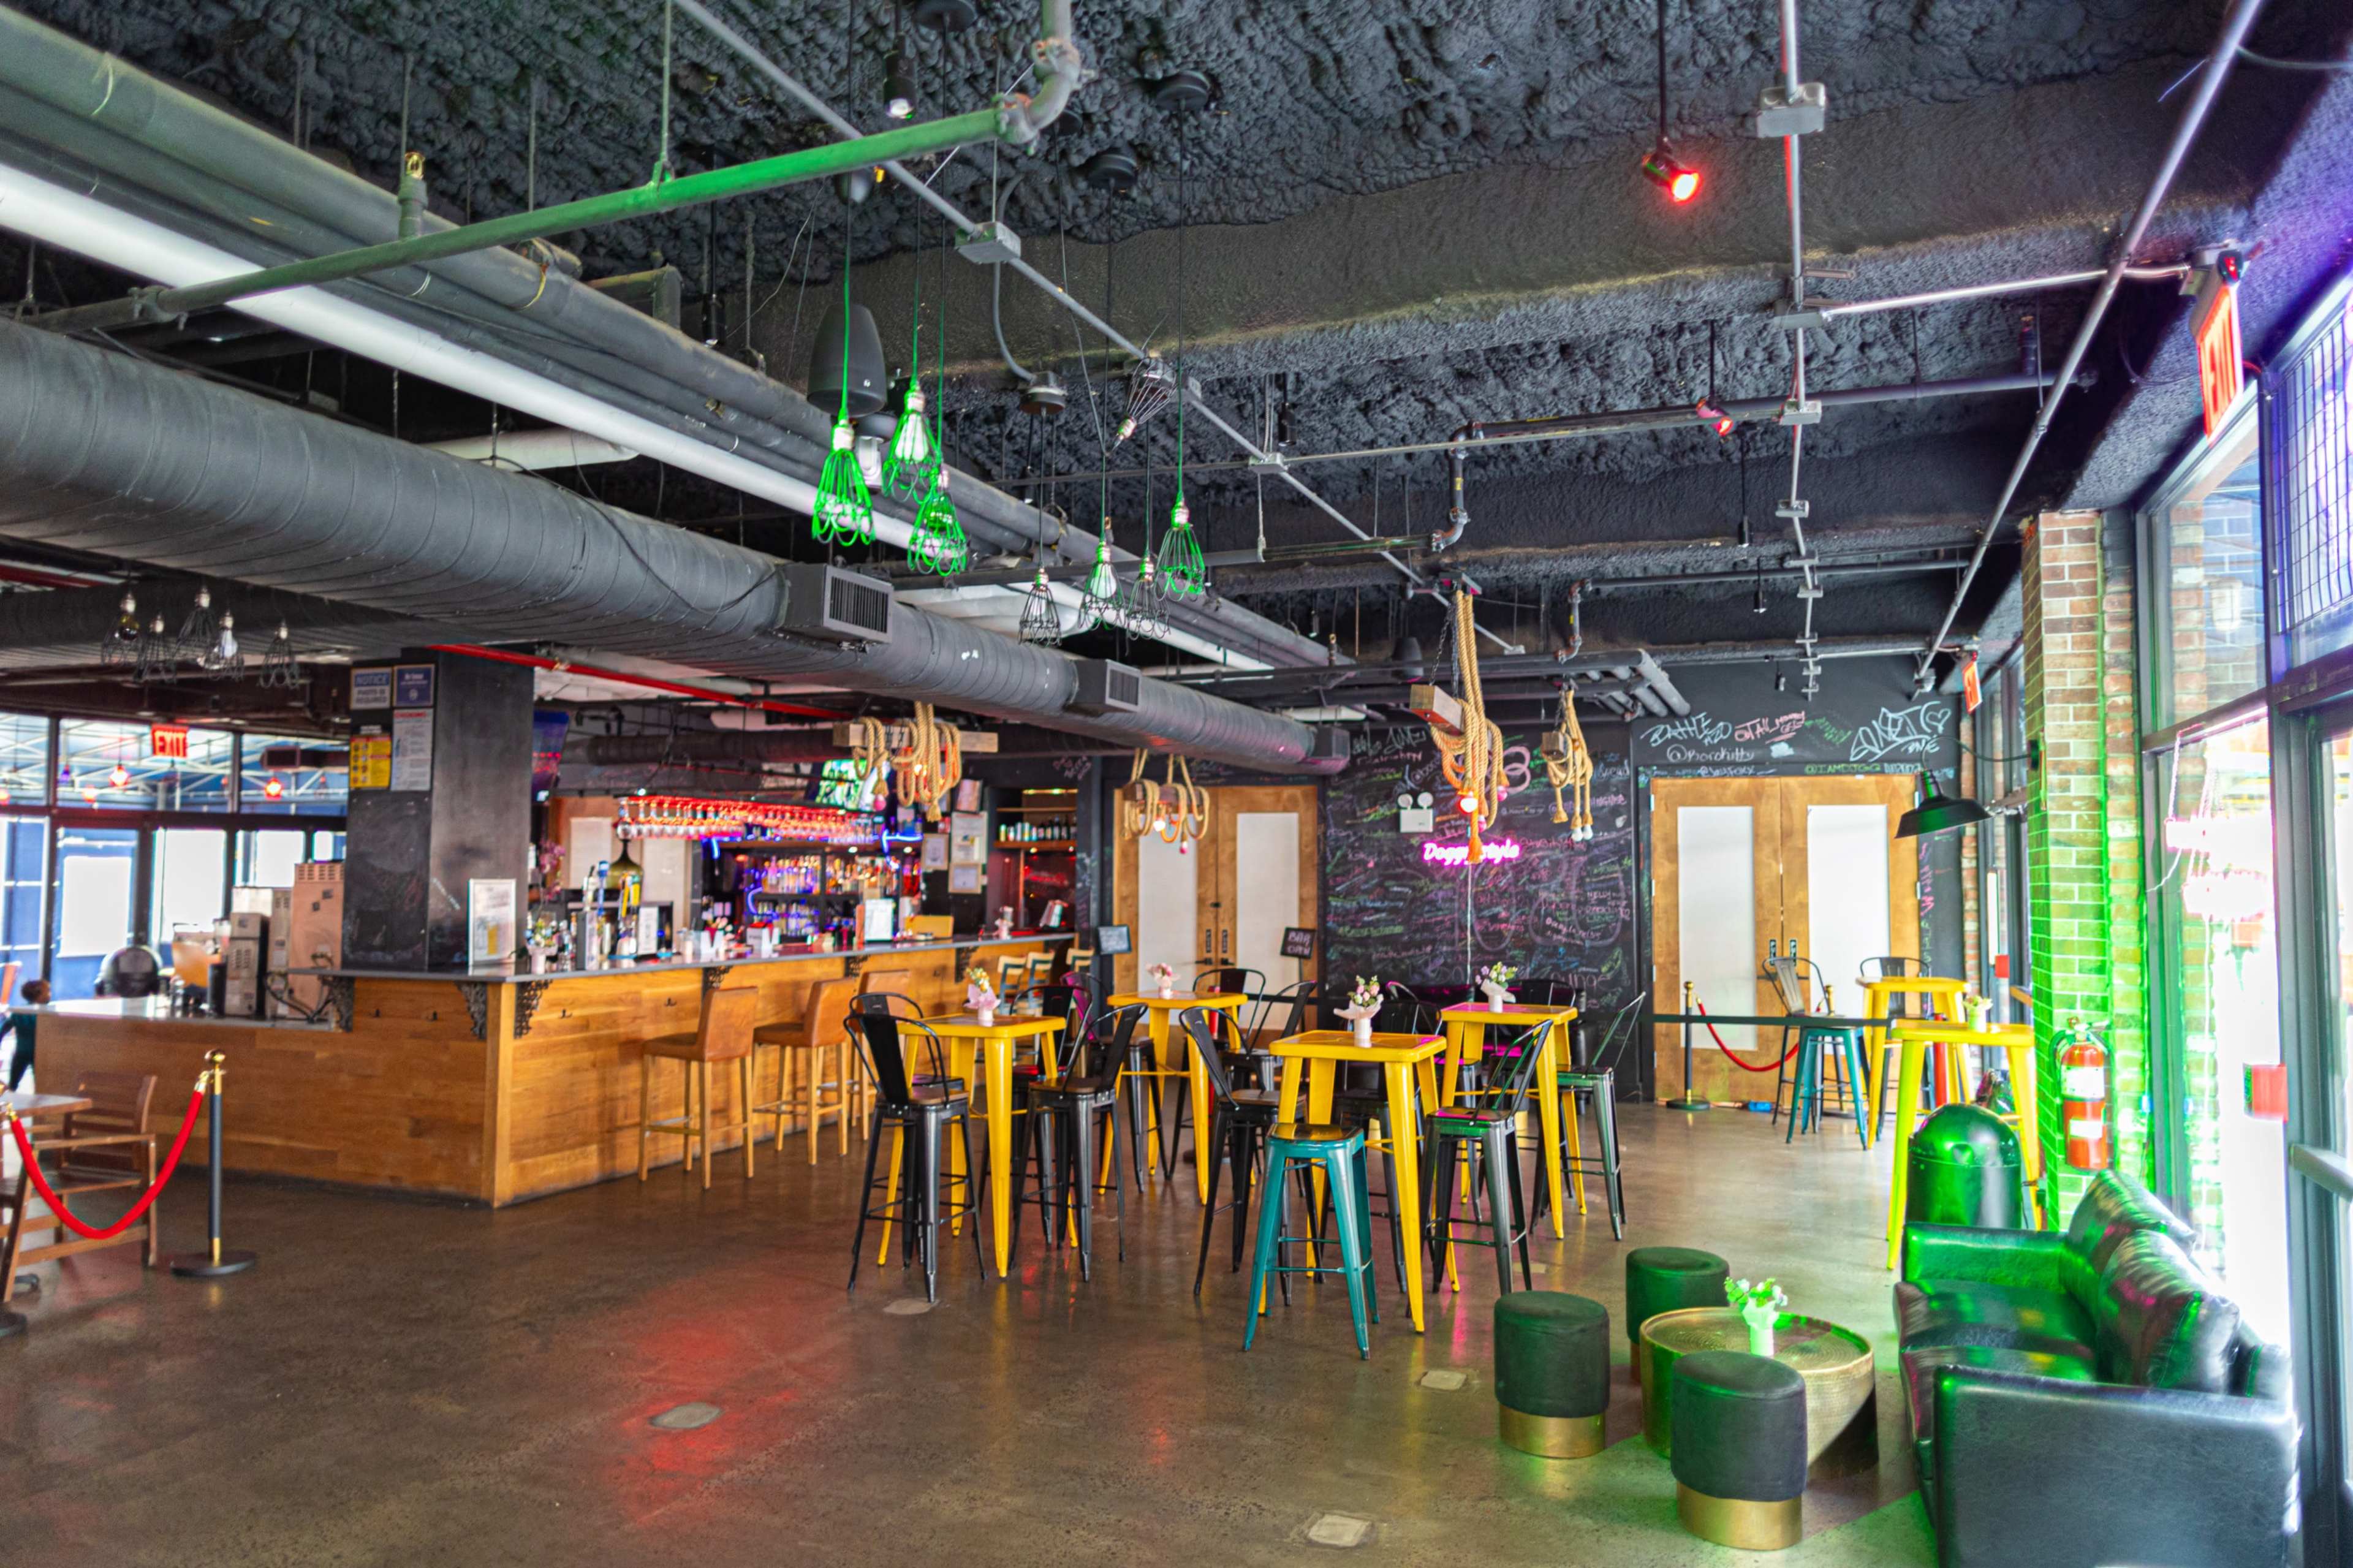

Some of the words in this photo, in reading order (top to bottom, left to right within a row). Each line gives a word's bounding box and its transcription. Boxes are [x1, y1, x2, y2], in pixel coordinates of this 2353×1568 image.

[154, 730, 186, 757] EXIT
[1423, 838, 1520, 866] Doggtyle
[1287, 930, 1310, 945] BAR
